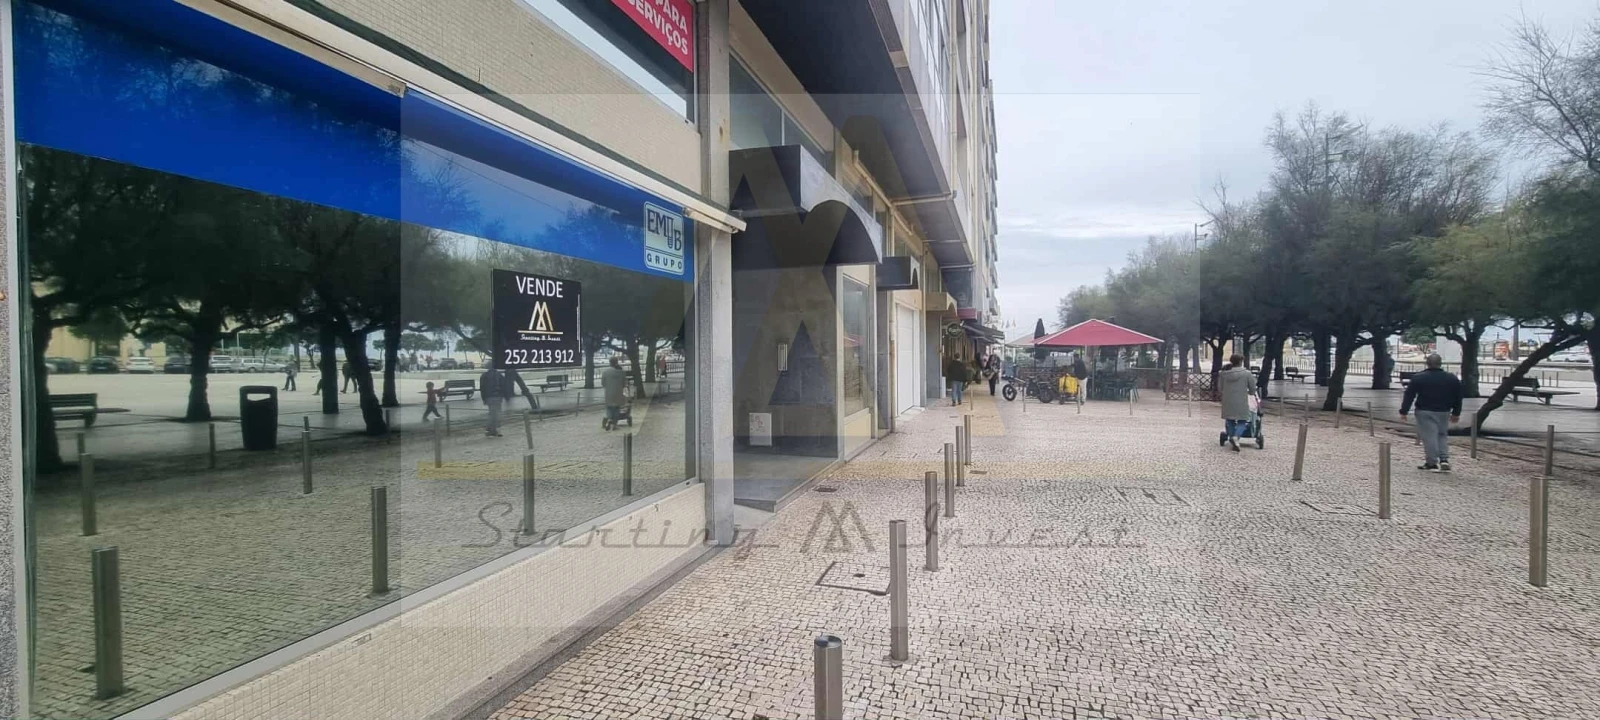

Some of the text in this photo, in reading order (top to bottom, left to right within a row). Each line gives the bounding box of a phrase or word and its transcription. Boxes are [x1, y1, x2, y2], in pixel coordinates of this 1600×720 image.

[646, 253, 683, 270] GRUPO
[515, 275, 564, 298] VENDE
[504, 349, 575, 364] 252 213 912
